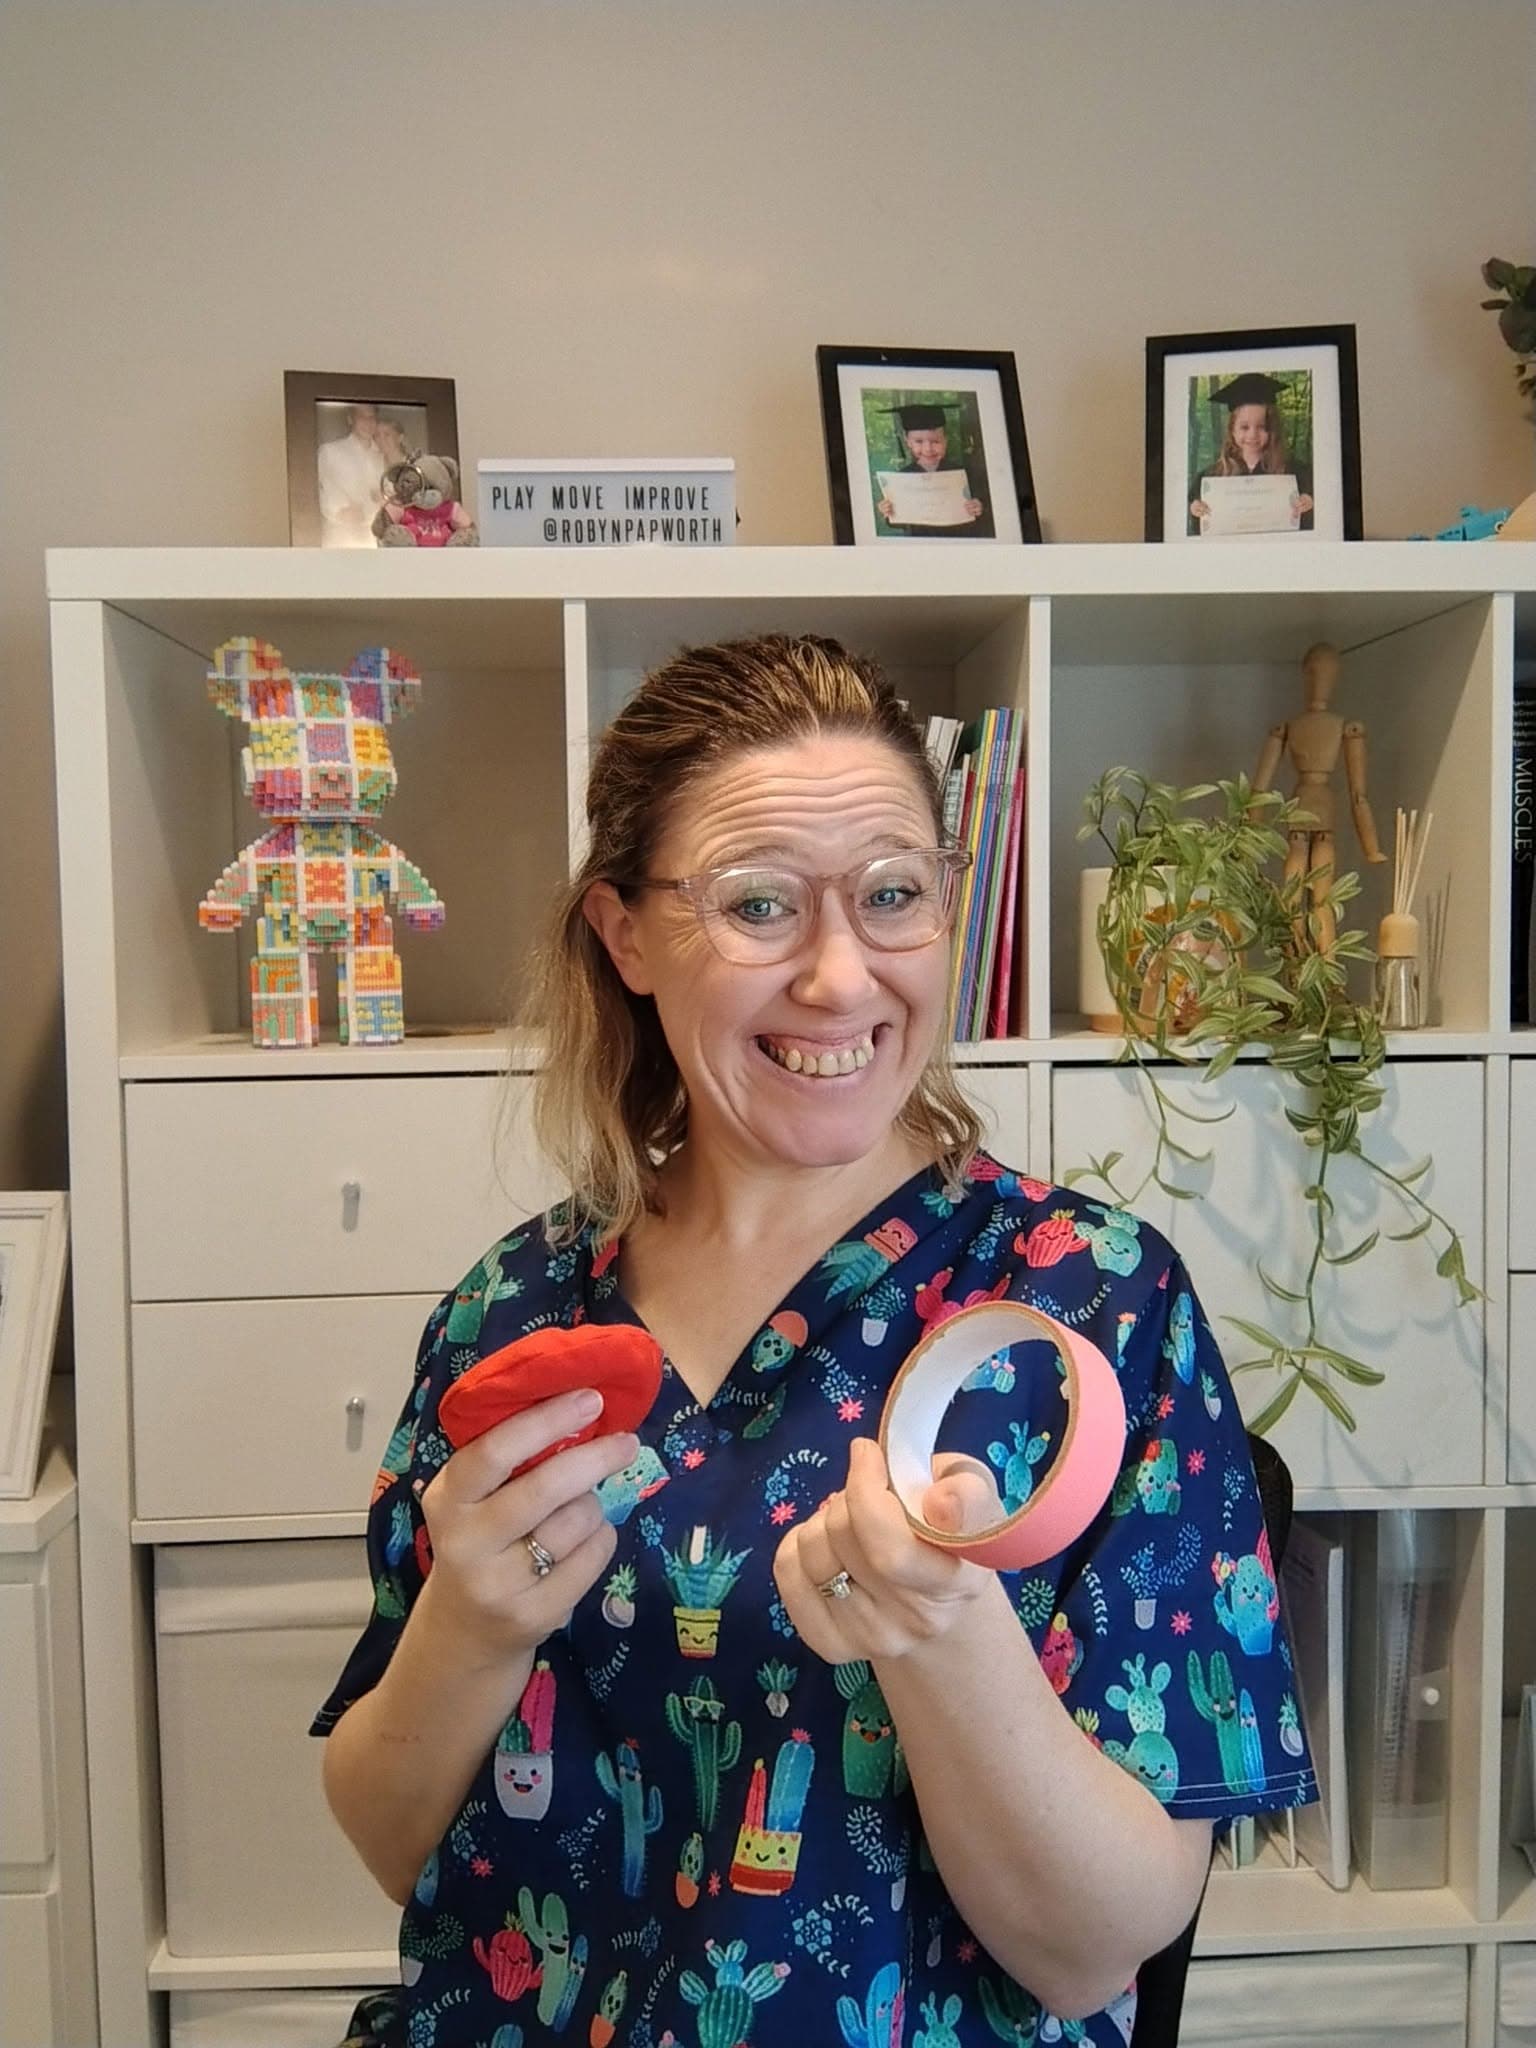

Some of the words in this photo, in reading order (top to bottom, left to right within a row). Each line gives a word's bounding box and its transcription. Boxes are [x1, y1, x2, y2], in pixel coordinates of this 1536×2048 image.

[492, 486, 534, 510] PLAY
[552, 485, 604, 510] MOVE
[625, 486, 709, 510] IMPROVE
[543, 517, 721, 543] @ROBYNPAPWORTH
[1514, 758, 1533, 862] MUSCLES
